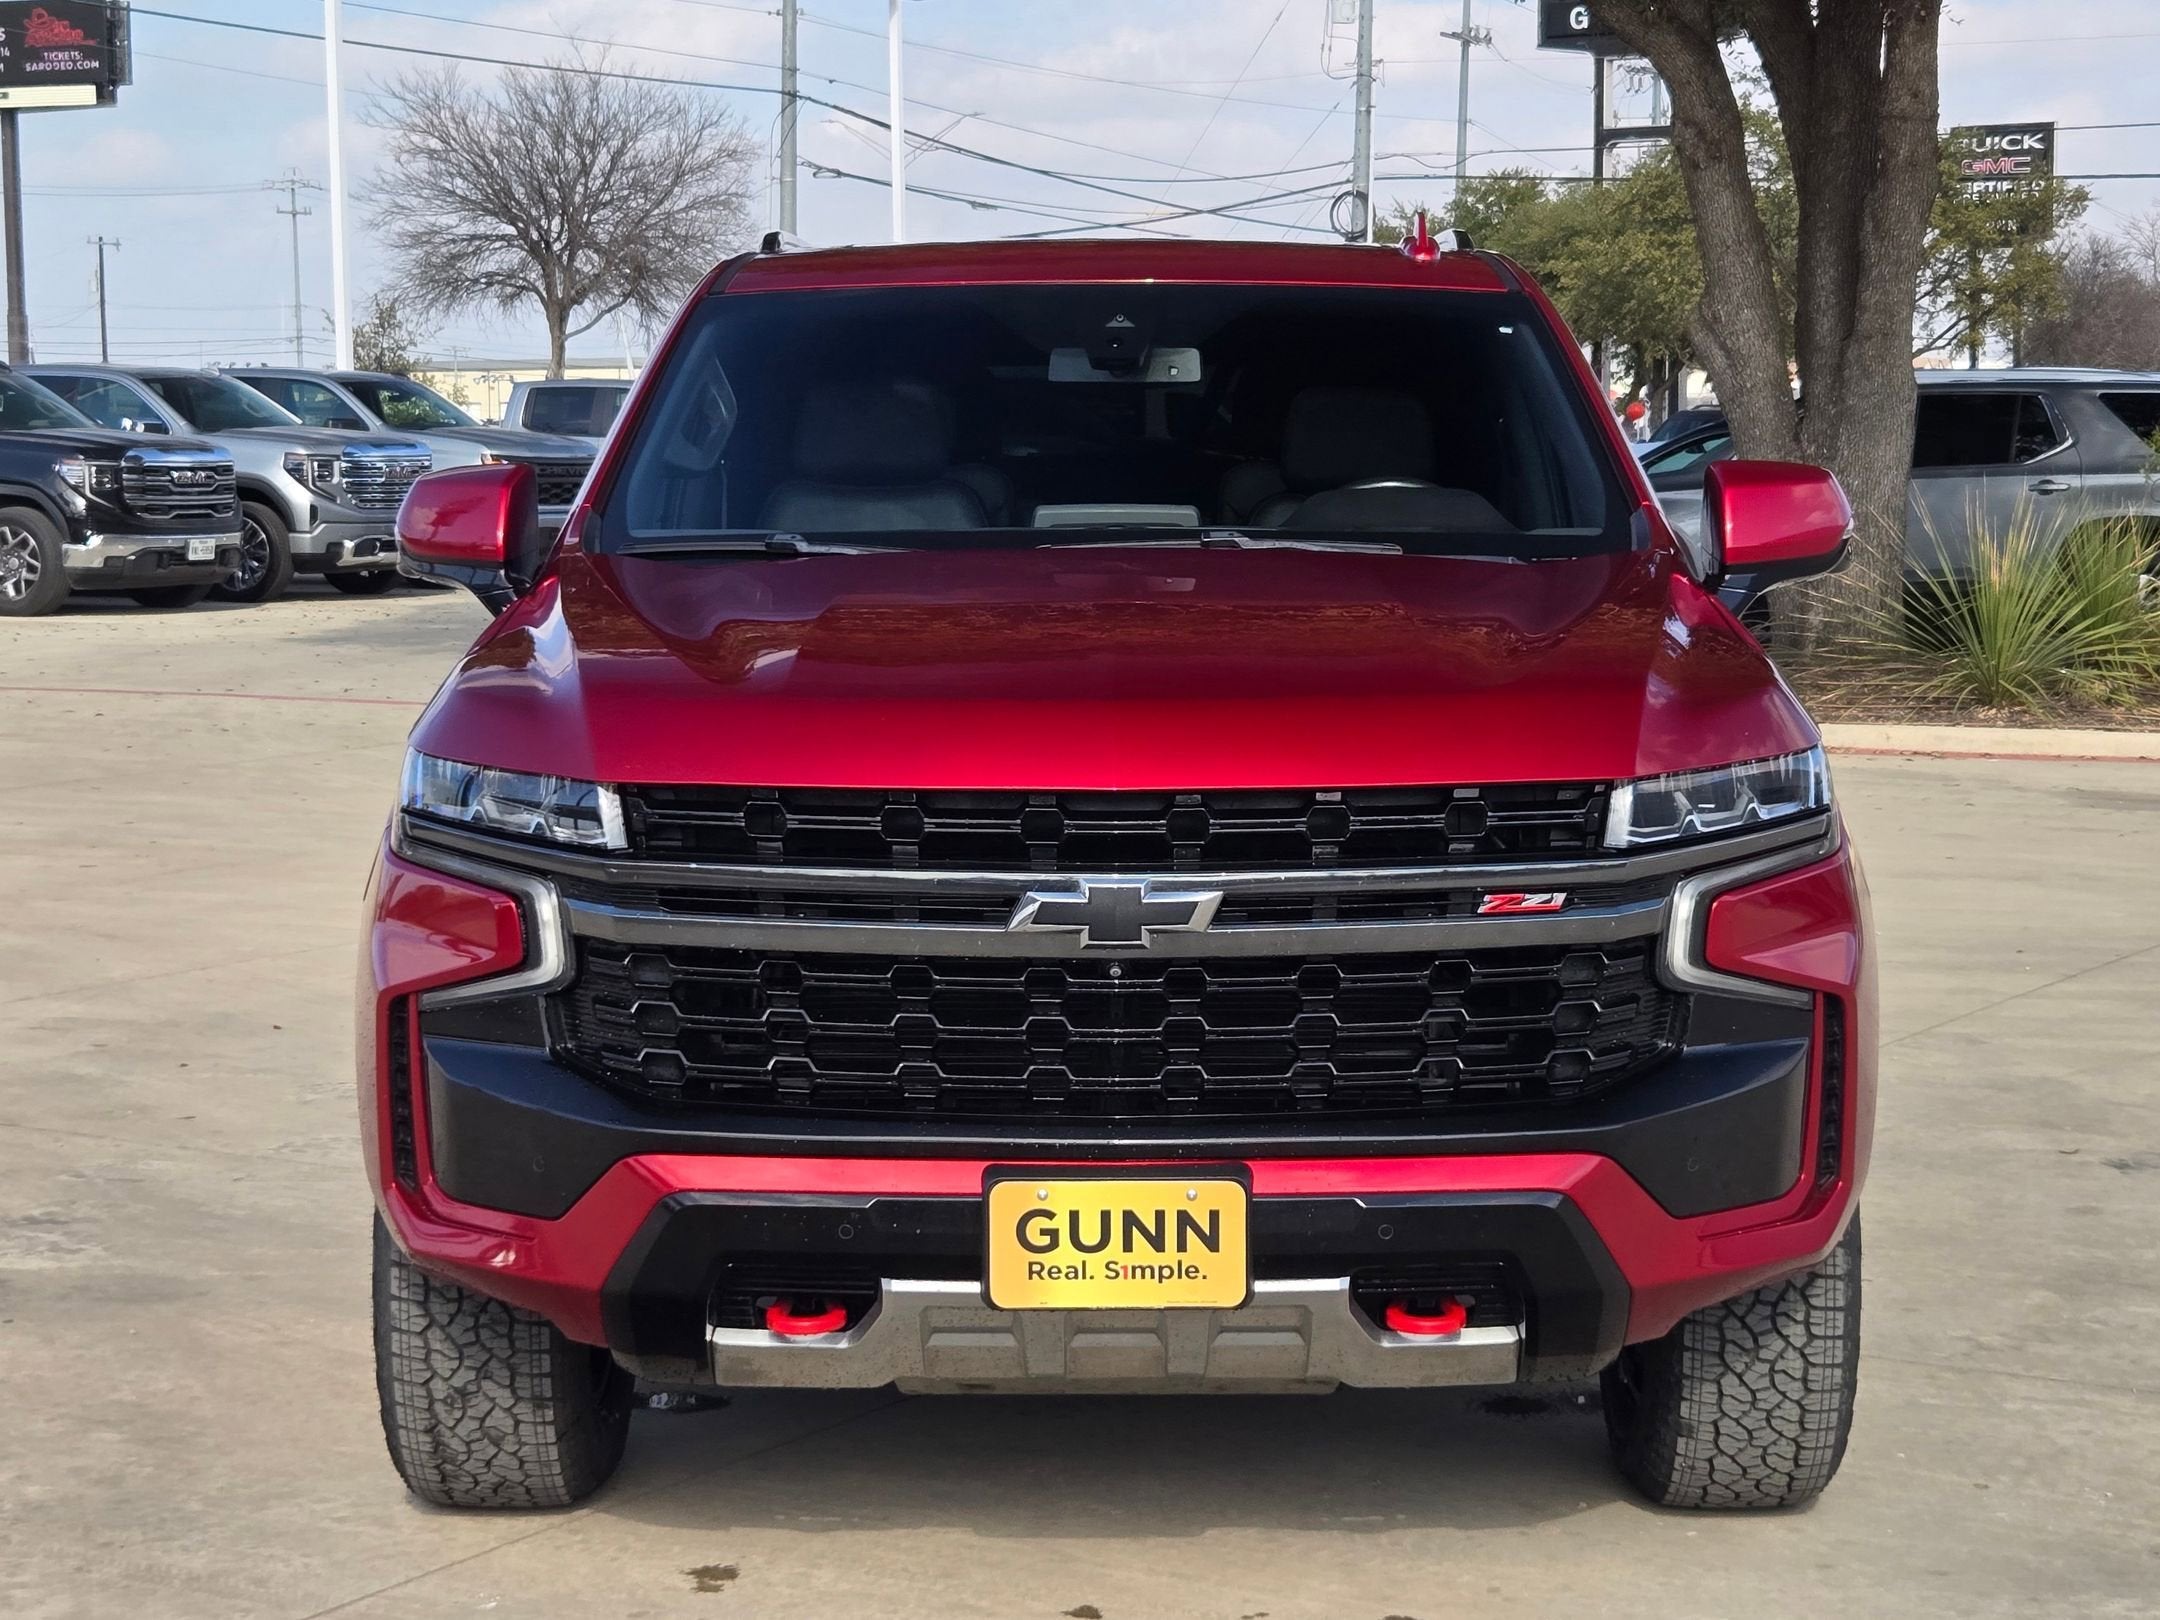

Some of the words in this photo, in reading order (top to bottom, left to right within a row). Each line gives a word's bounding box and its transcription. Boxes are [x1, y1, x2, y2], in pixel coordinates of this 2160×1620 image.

[43, 51, 84, 60] TICKETS:
[25, 60, 100, 72] SARODEO.COM
[1961, 156, 2031, 176] GMC
[1016, 1208, 1220, 1254] GUNN
[1028, 1260, 1094, 1281] Real.
